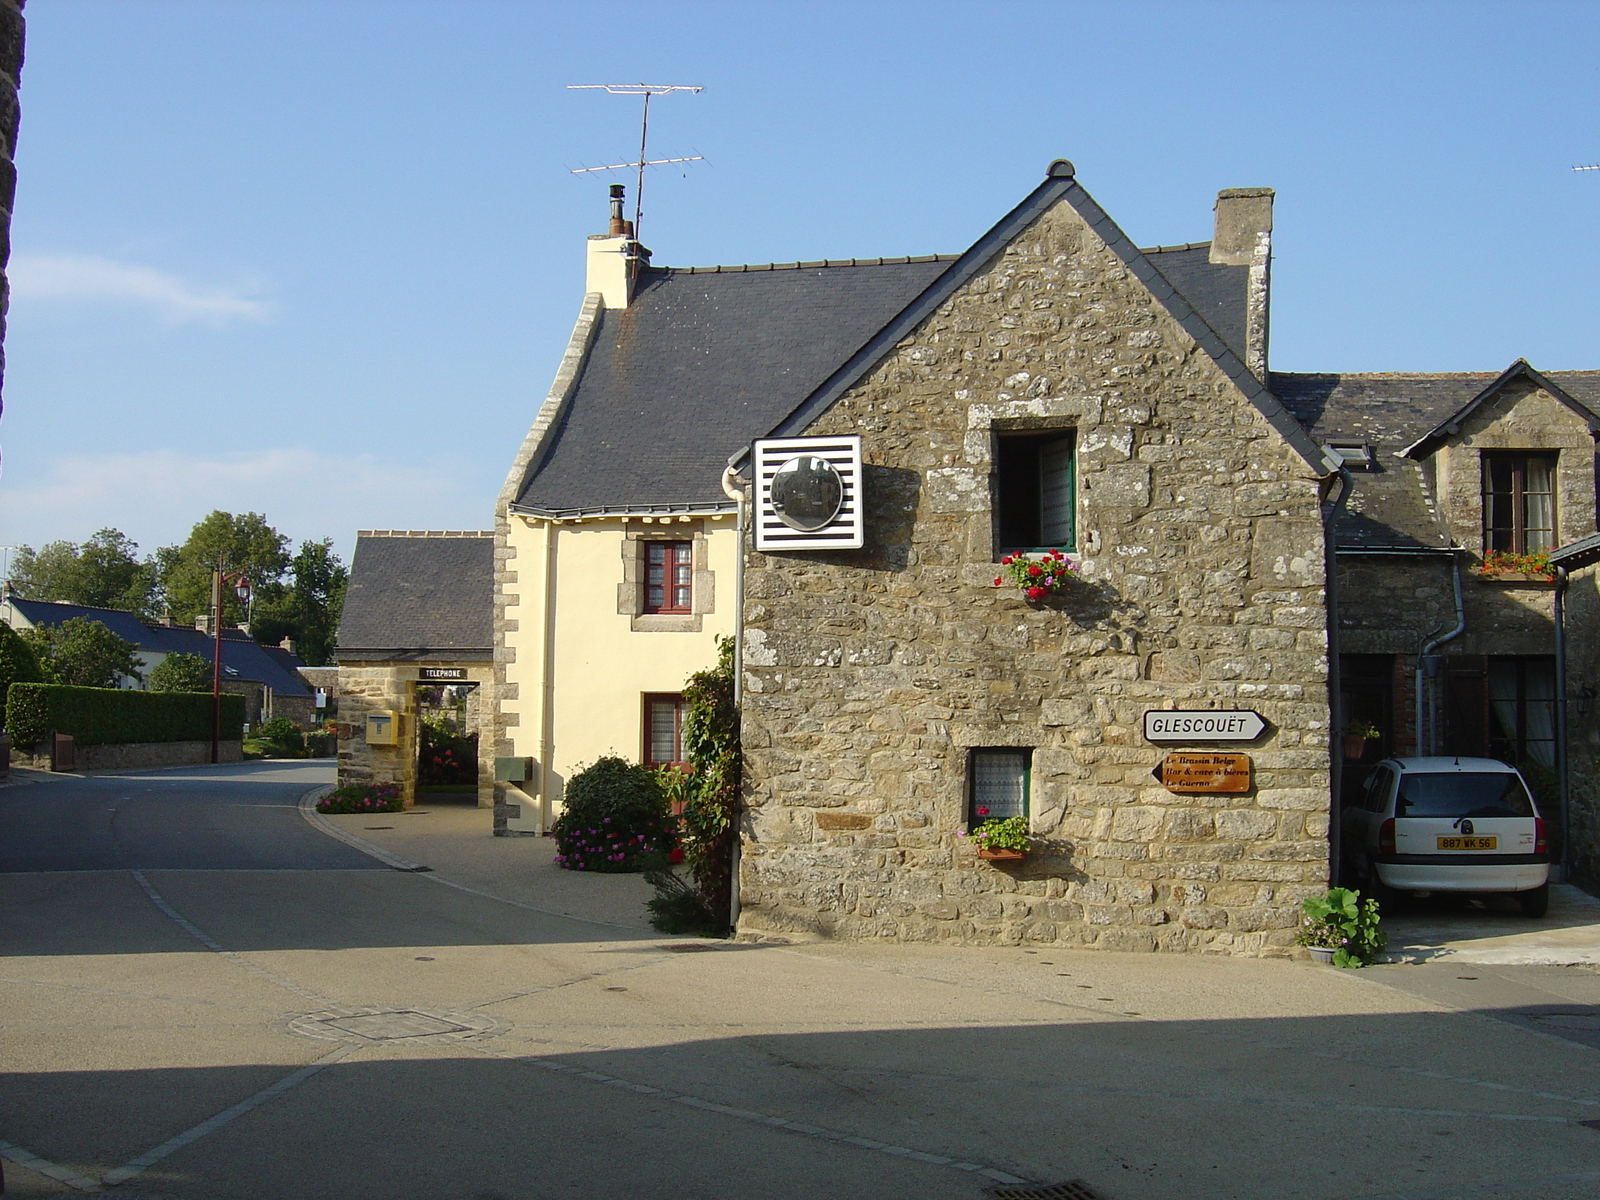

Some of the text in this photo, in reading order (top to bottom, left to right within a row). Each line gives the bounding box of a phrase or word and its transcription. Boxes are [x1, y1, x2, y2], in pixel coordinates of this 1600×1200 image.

[1152, 715, 1247, 733] GLESCOUËT
[1212, 757, 1236, 766] Belge
[1223, 768, 1249, 776] bières
[1442, 839, 1490, 848] 887 WK 56
